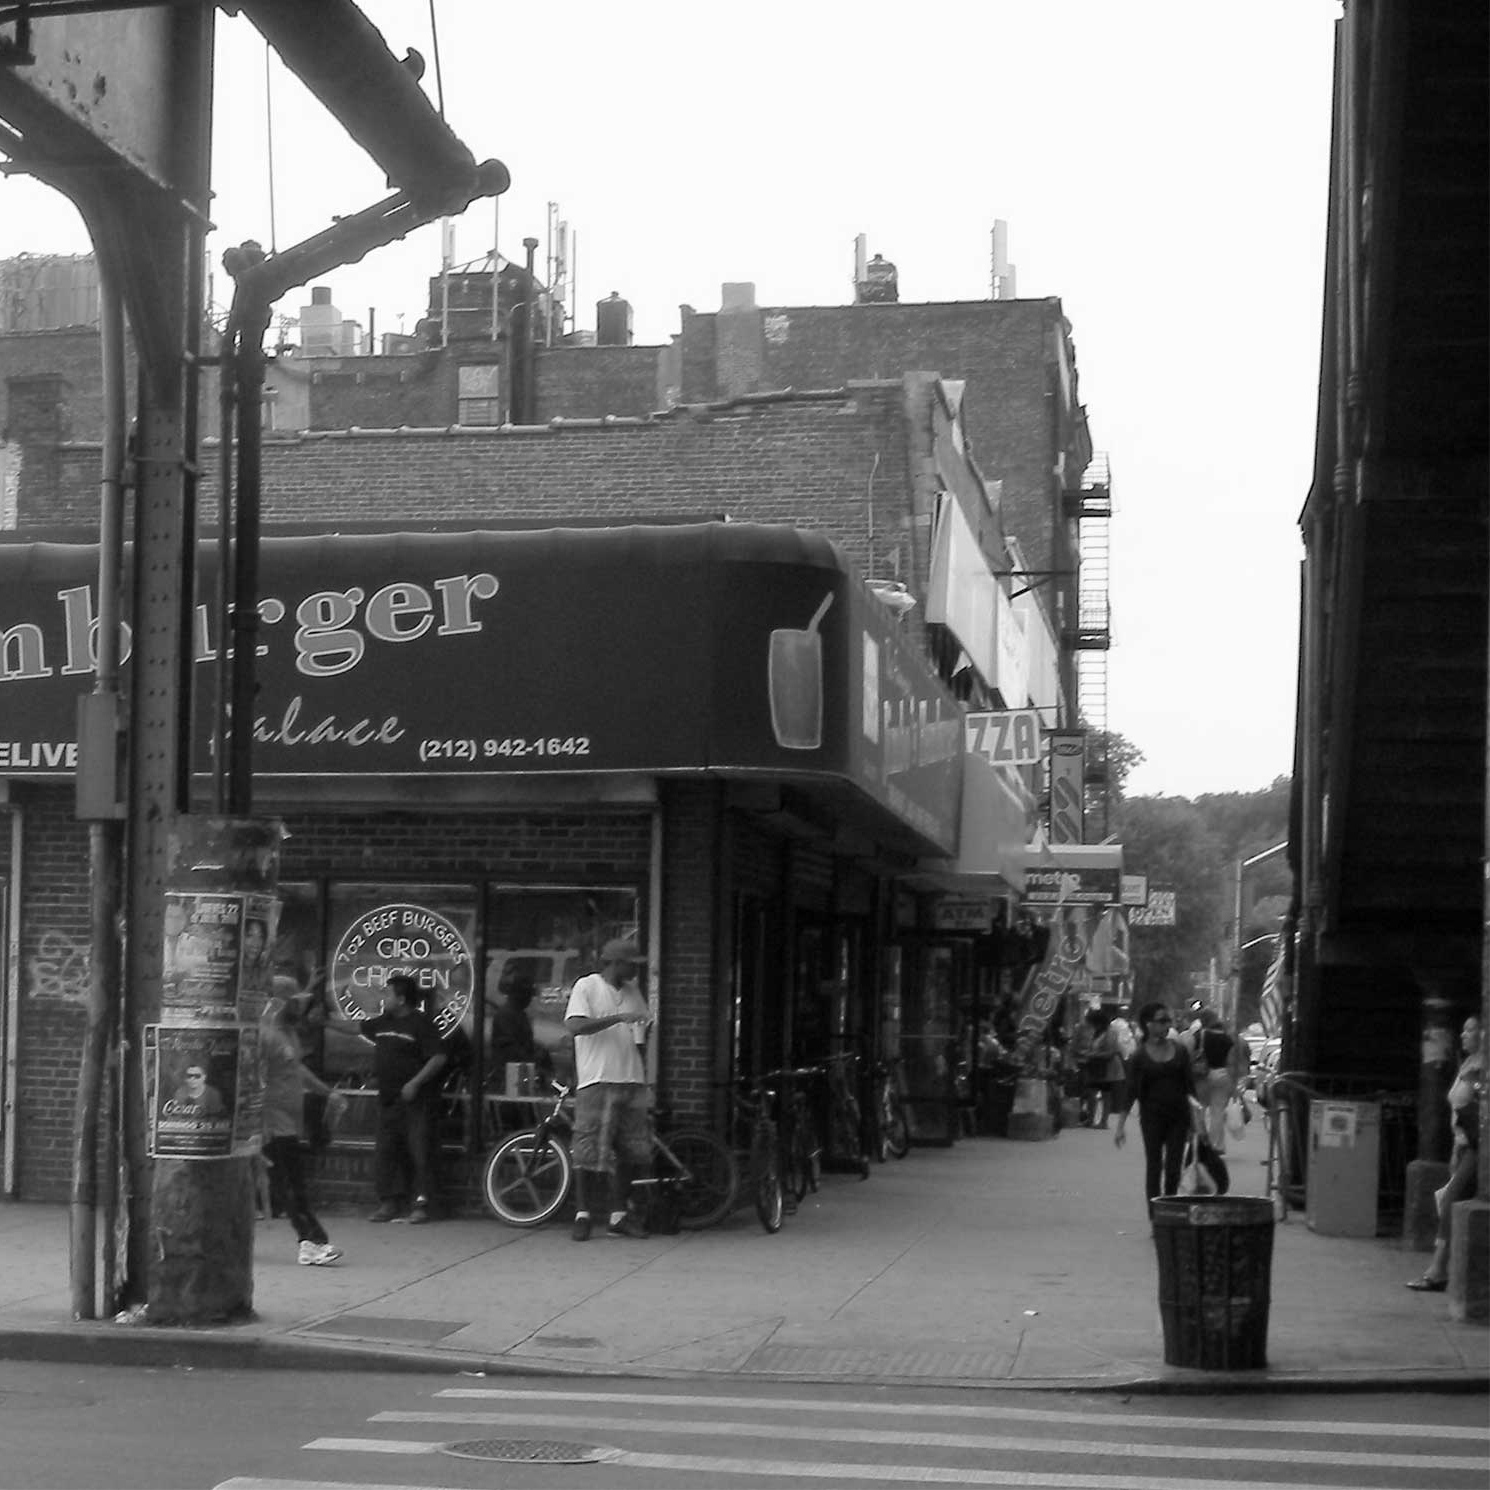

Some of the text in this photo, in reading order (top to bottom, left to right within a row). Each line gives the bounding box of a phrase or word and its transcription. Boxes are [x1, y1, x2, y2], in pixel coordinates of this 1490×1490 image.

[209, 694, 406, 755] alace
[968, 713, 1035, 762] ZZA
[418, 737, 590, 762] (212) 942-1642
[1025, 871, 1081, 886] meto
[361, 910, 399, 937] BEEF
[401, 911, 468, 965] BURGERS
